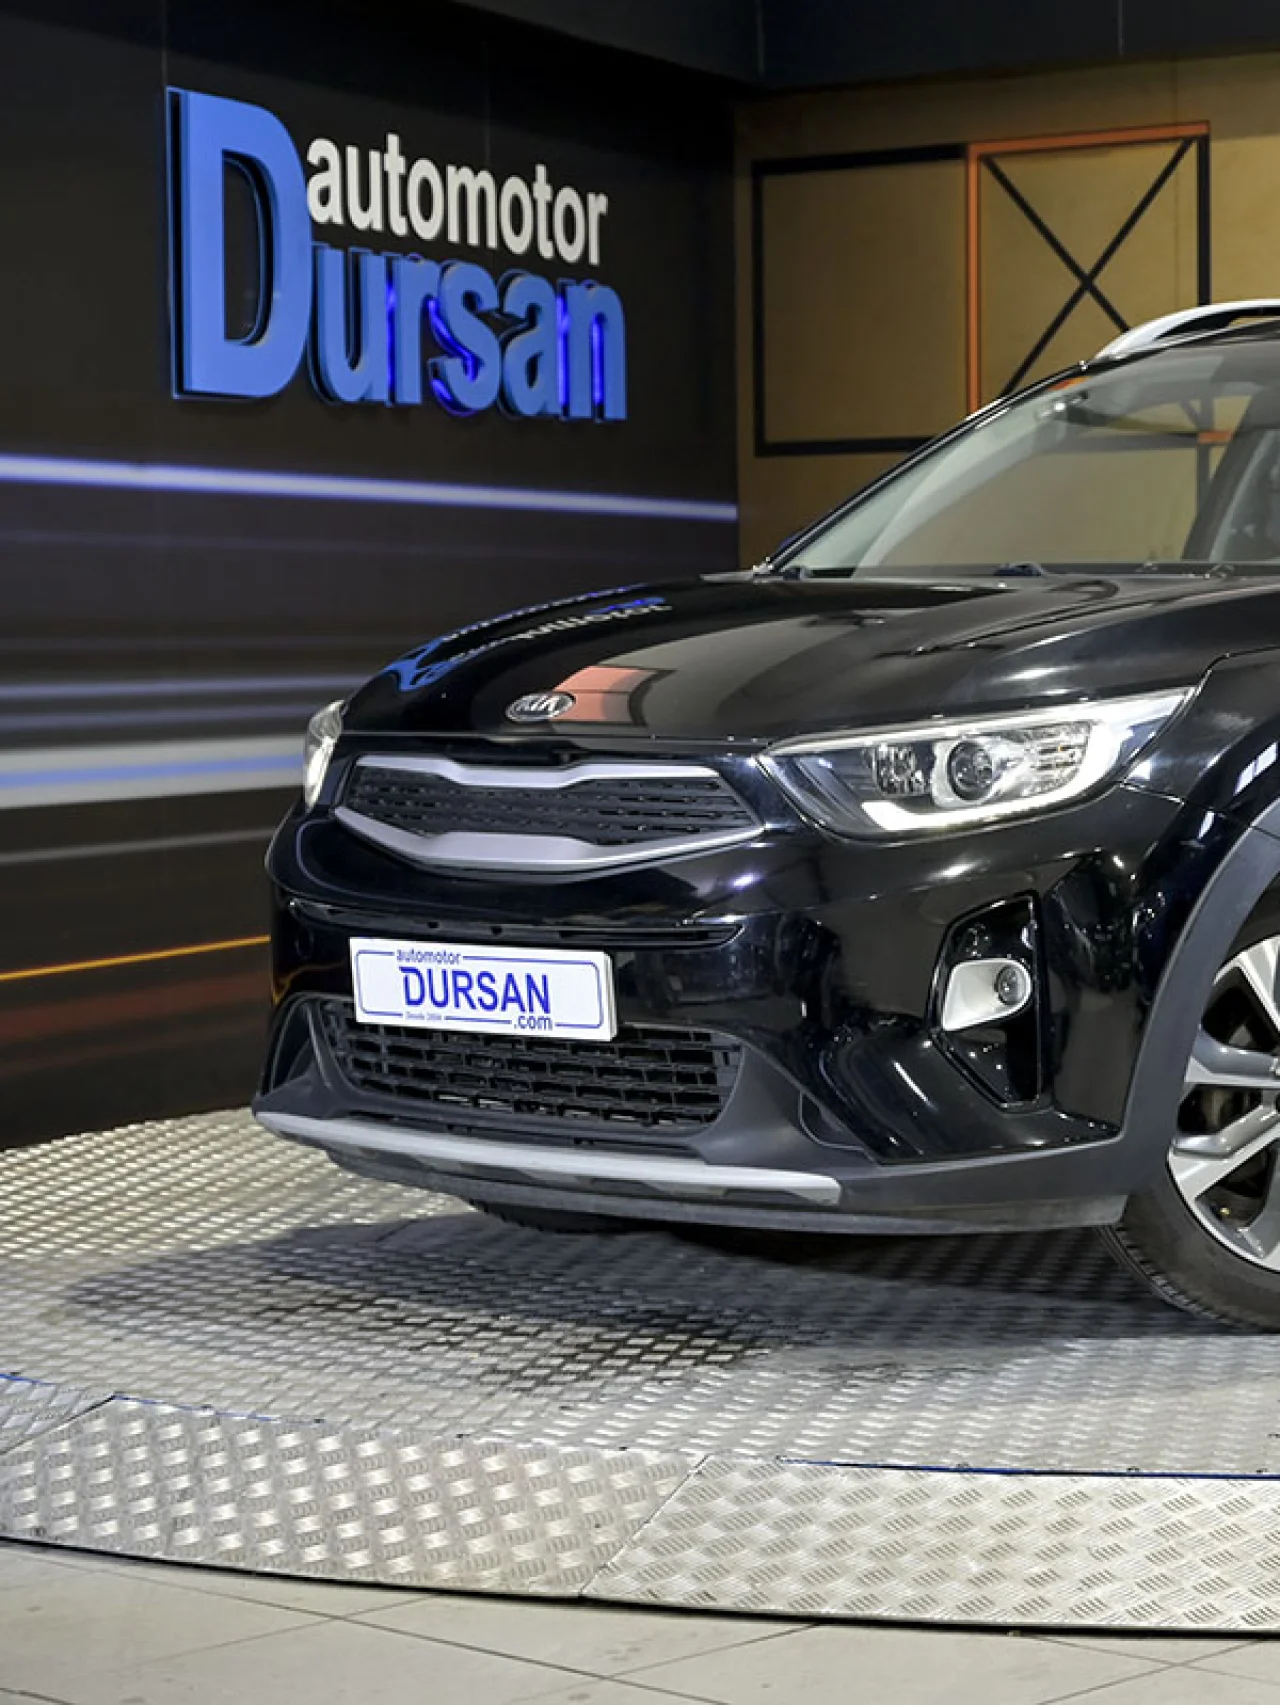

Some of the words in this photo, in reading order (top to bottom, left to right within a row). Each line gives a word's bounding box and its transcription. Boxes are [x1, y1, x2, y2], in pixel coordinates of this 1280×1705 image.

[306, 133, 609, 265] automotor
[166, 86, 627, 421] Dursan
[397, 948, 461, 965] automotor
[399, 966, 550, 1014] DURSAN
[514, 1014, 553, 1031] .com
